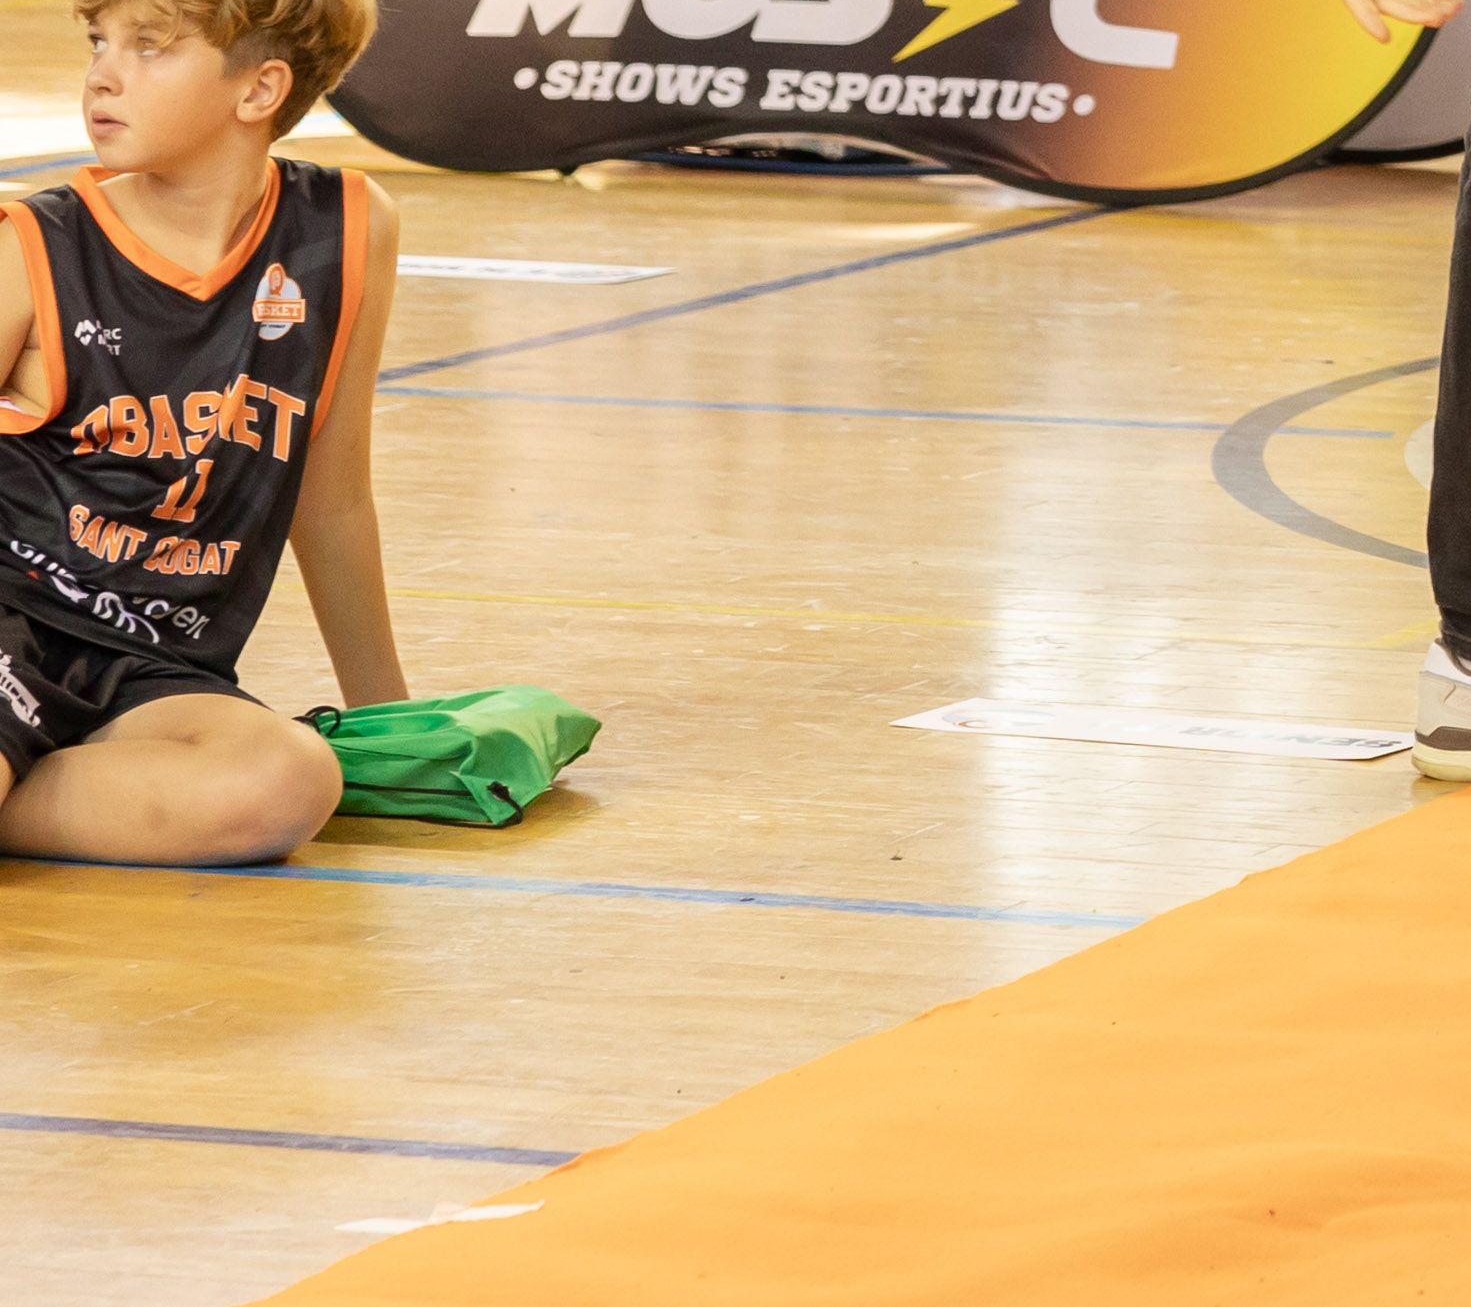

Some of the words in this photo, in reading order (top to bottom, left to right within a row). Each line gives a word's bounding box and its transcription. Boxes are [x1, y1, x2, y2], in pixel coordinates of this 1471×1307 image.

[541, 60, 747, 109] SHOWS
[759, 68, 1069, 124] ESPORTIUS
[69, 505, 147, 563] SANT
